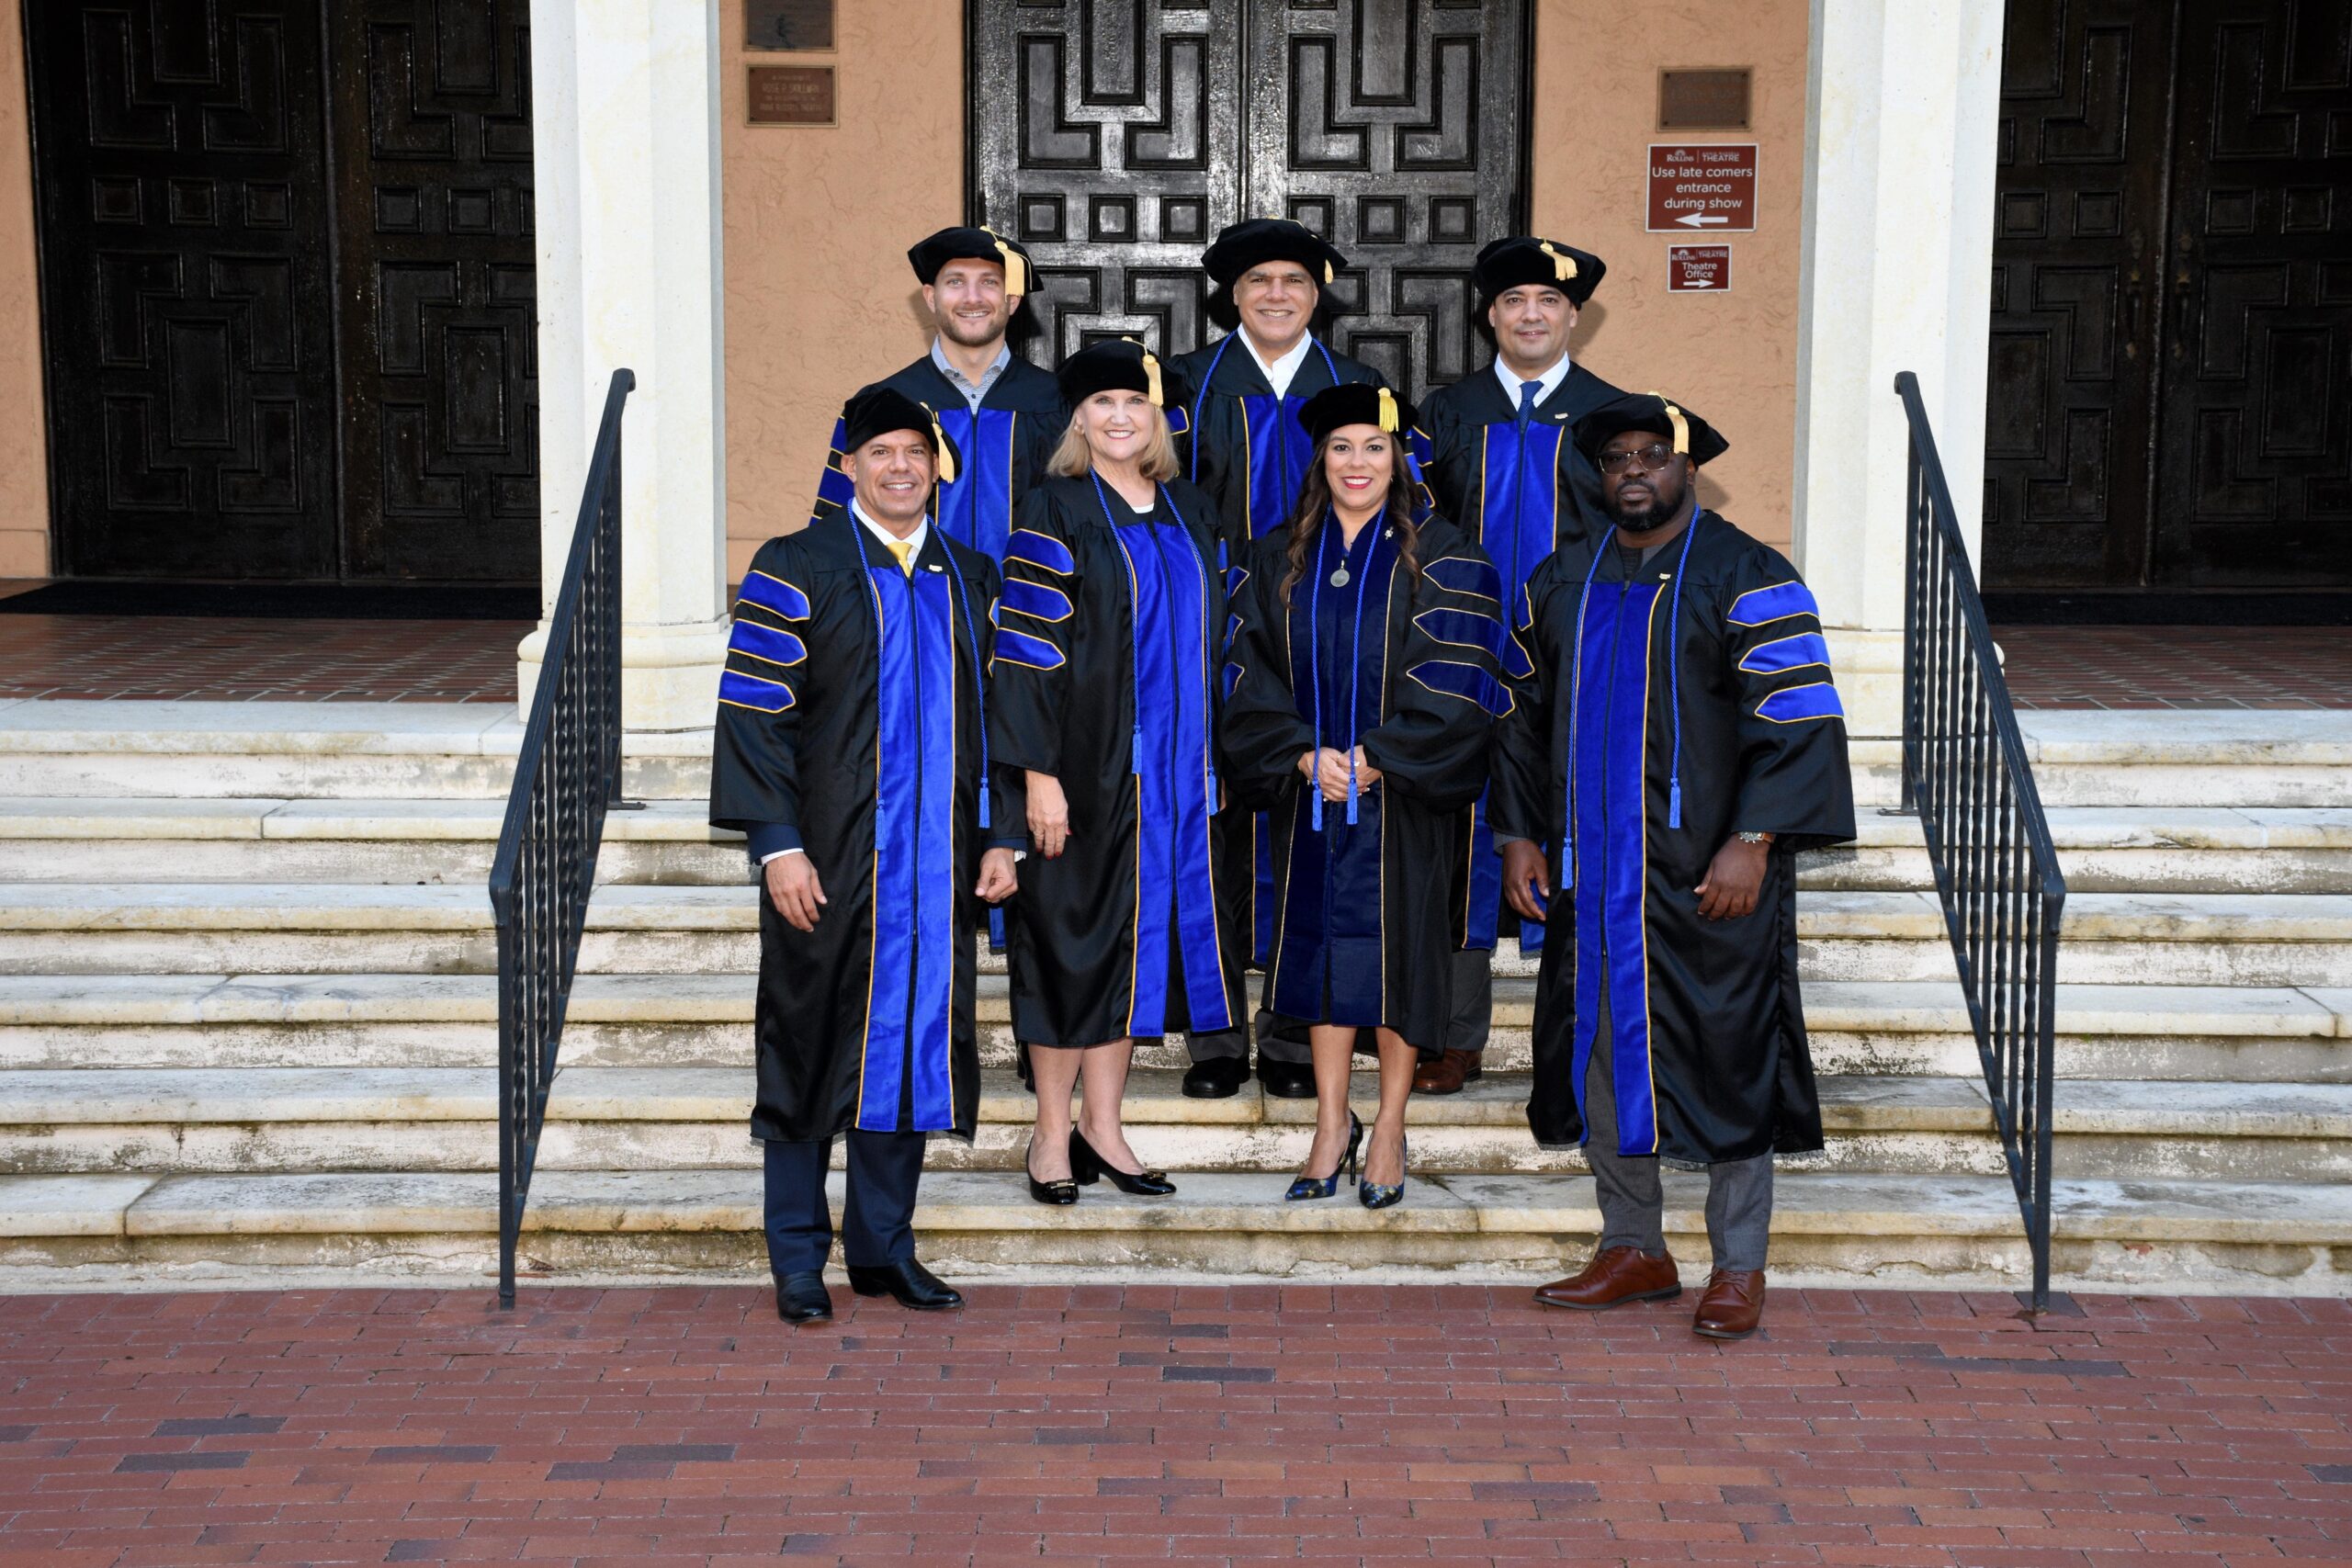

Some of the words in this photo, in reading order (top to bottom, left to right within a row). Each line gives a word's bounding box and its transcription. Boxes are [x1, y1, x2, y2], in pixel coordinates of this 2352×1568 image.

[1652, 166, 1676, 177] Use
[1679, 166, 1702, 177] late
[1706, 168, 1753, 177] comers
[1676, 184, 1732, 193] entrance
[1664, 198, 1705, 210] during
[1709, 197, 1742, 209] show
[1682, 262, 1717, 270] Theatre
[1685, 270, 1713, 278] Office
